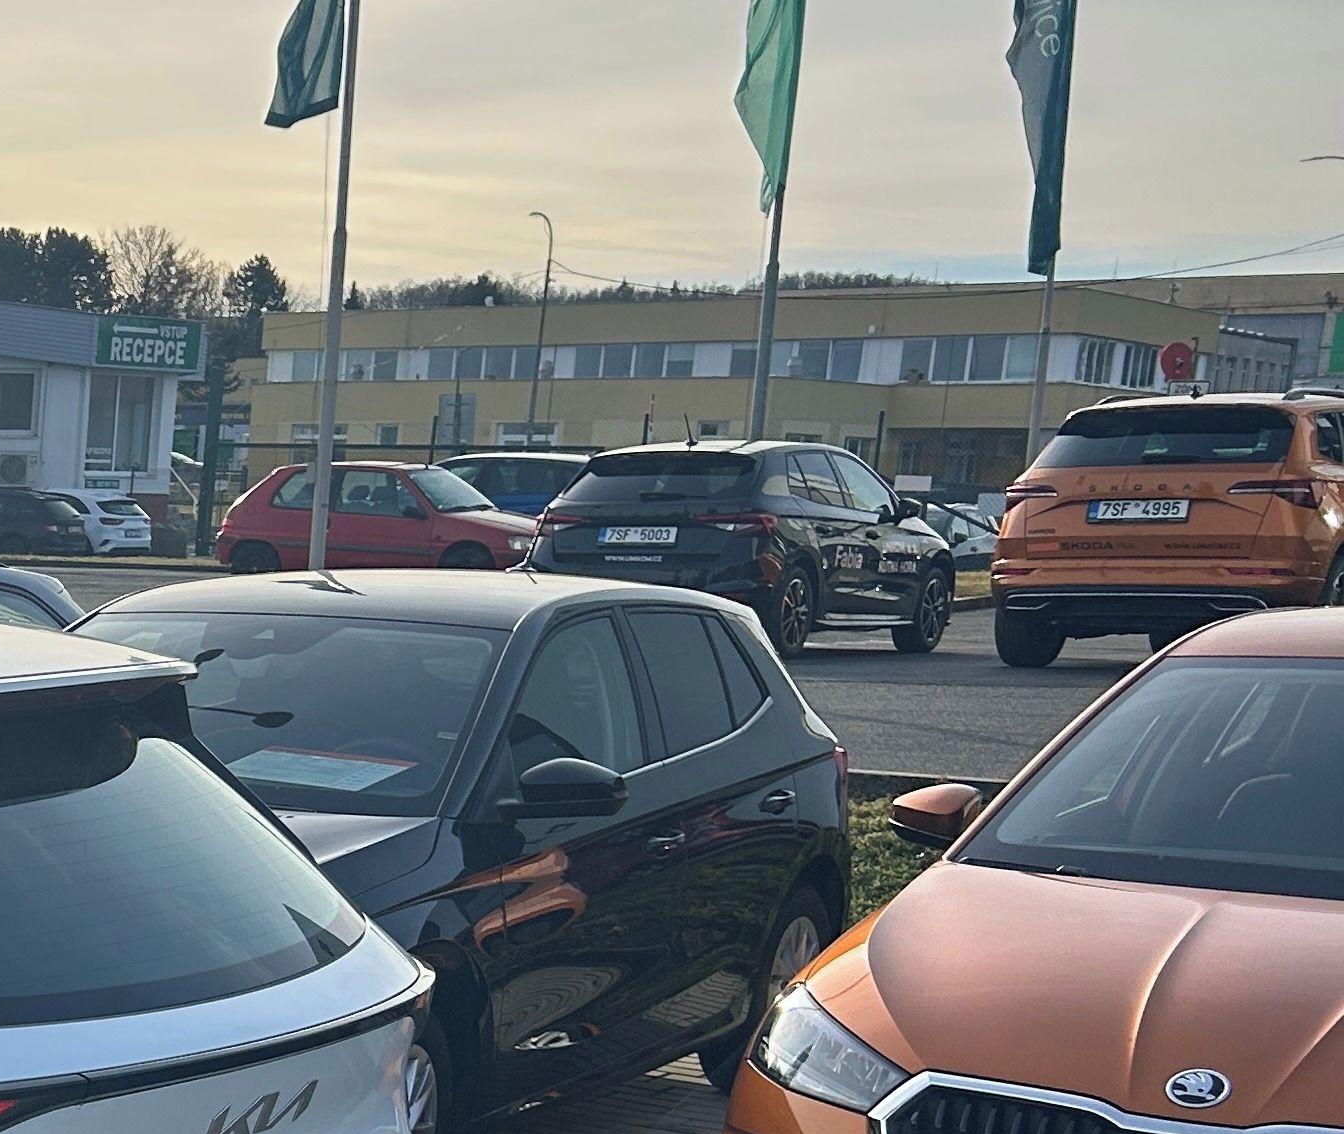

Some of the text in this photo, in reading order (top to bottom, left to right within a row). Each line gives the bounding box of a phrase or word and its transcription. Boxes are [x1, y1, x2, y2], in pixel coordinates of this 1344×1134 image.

[159, 324, 188, 339] VSTUP
[110, 336, 187, 365] RECEPCE
[1100, 501, 1182, 517] 7SF 4995
[607, 528, 671, 541] 7SF 5003
[834, 545, 864, 569] Fabia
